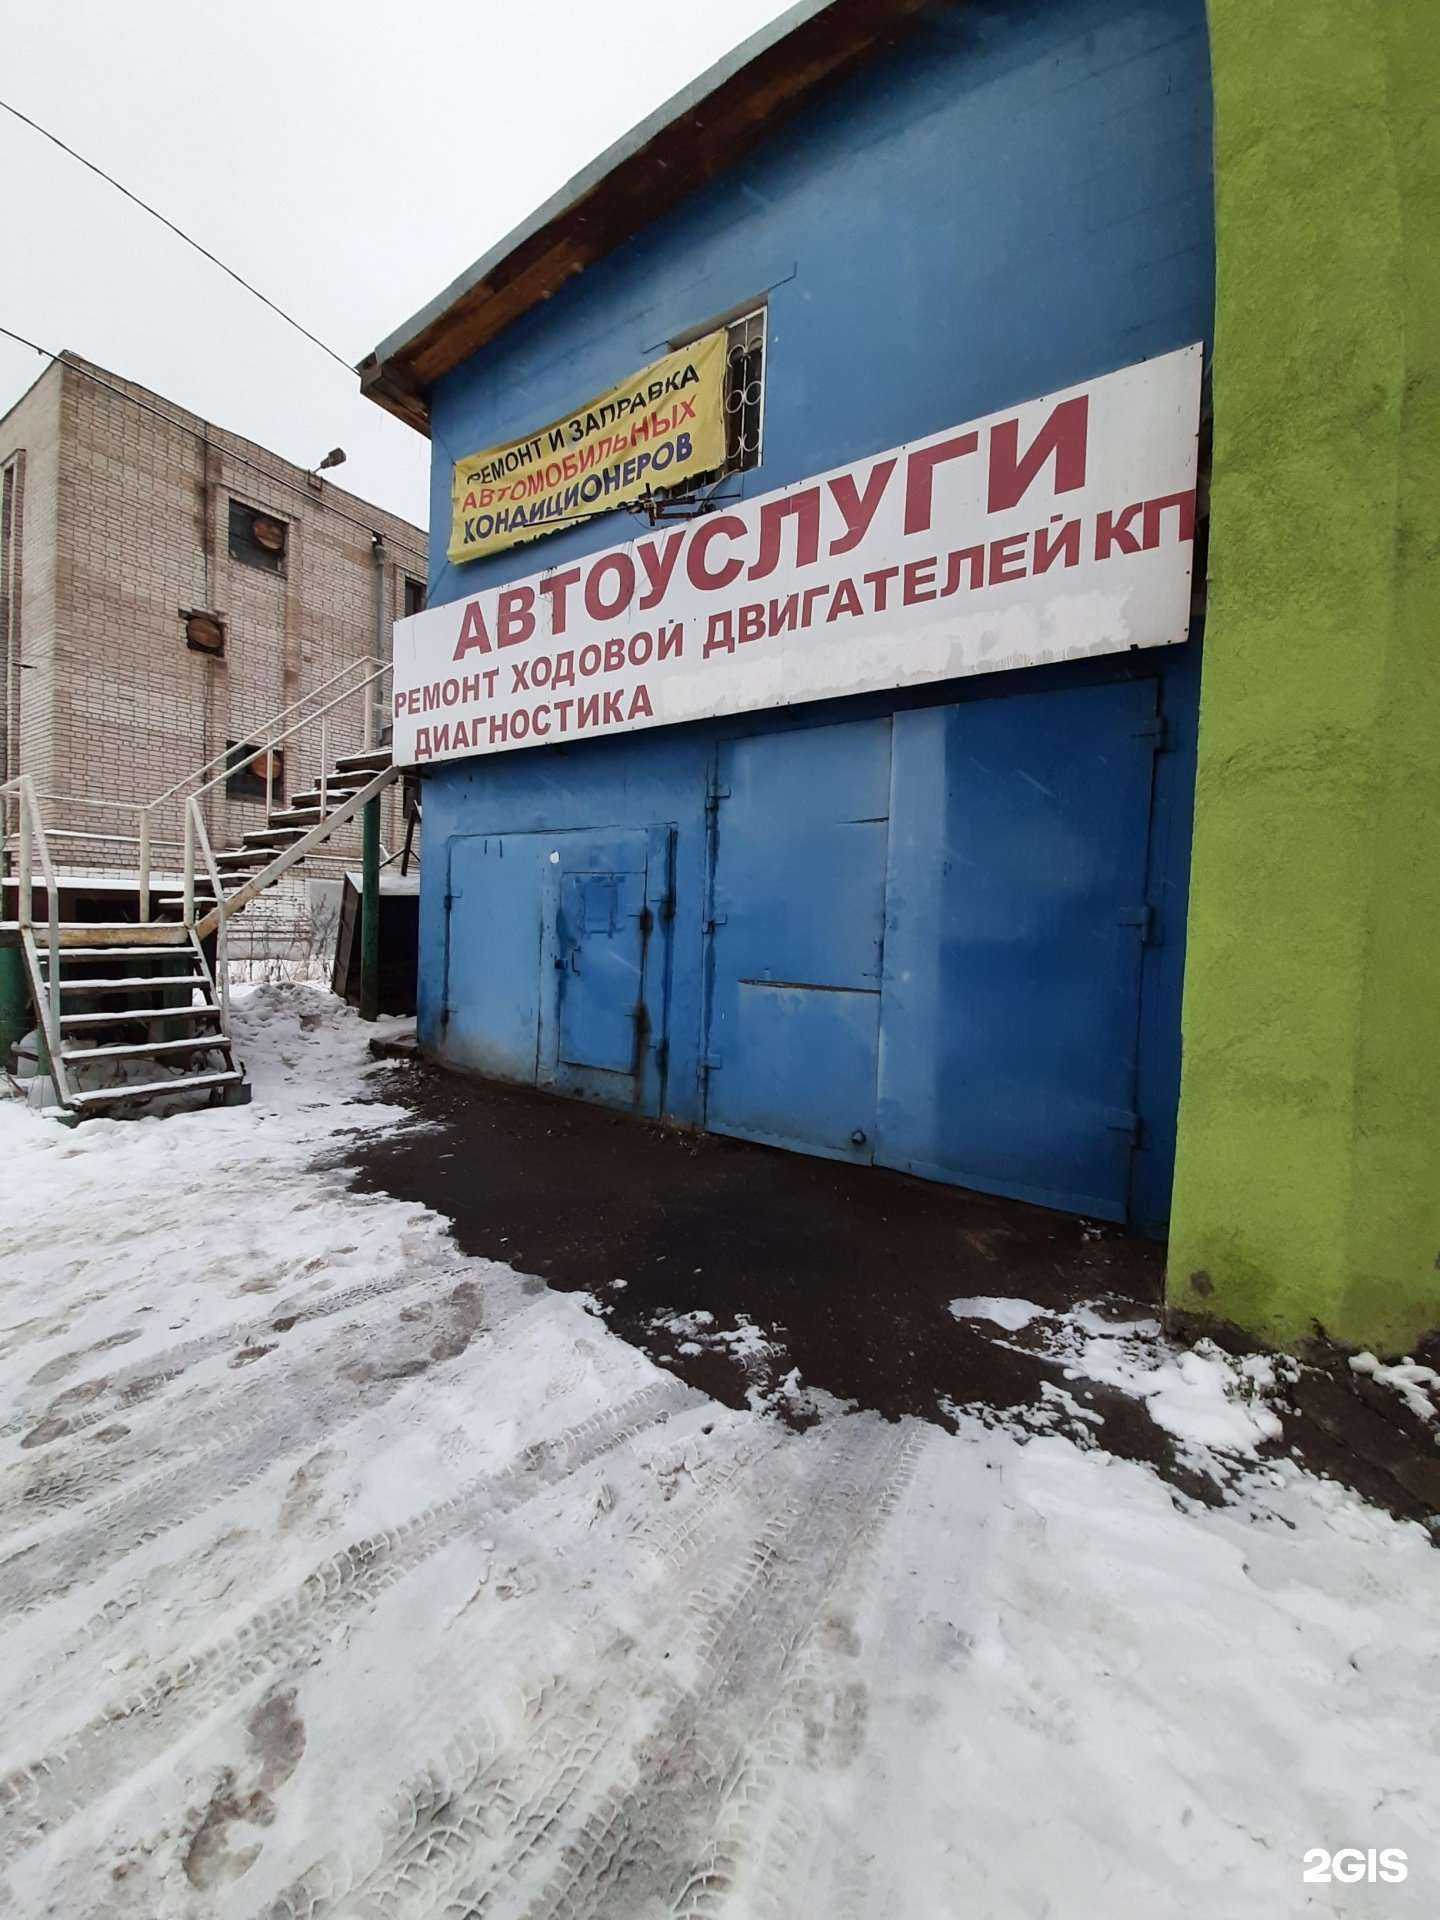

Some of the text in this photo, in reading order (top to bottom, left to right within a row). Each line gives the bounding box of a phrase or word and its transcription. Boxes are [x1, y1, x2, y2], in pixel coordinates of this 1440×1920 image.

[462, 394, 697, 512] АВТОМОБИЛЬНЫХ
[466, 363, 700, 485] РЕМОНТ И ЗАПРАВКА
[452, 393, 1090, 661] АВТОУСЛУГИ
[463, 432, 693, 544] КОНДИЦИОНЕРОВ
[394, 665, 500, 718] РЕМОНТ
[511, 618, 684, 694] ХОДОВОЙ
[702, 513, 1082, 659] ДВИГАТЕЛЕЙ
[1094, 488, 1197, 562] КП
[414, 684, 654, 761] ДИАГНОСТИКА
